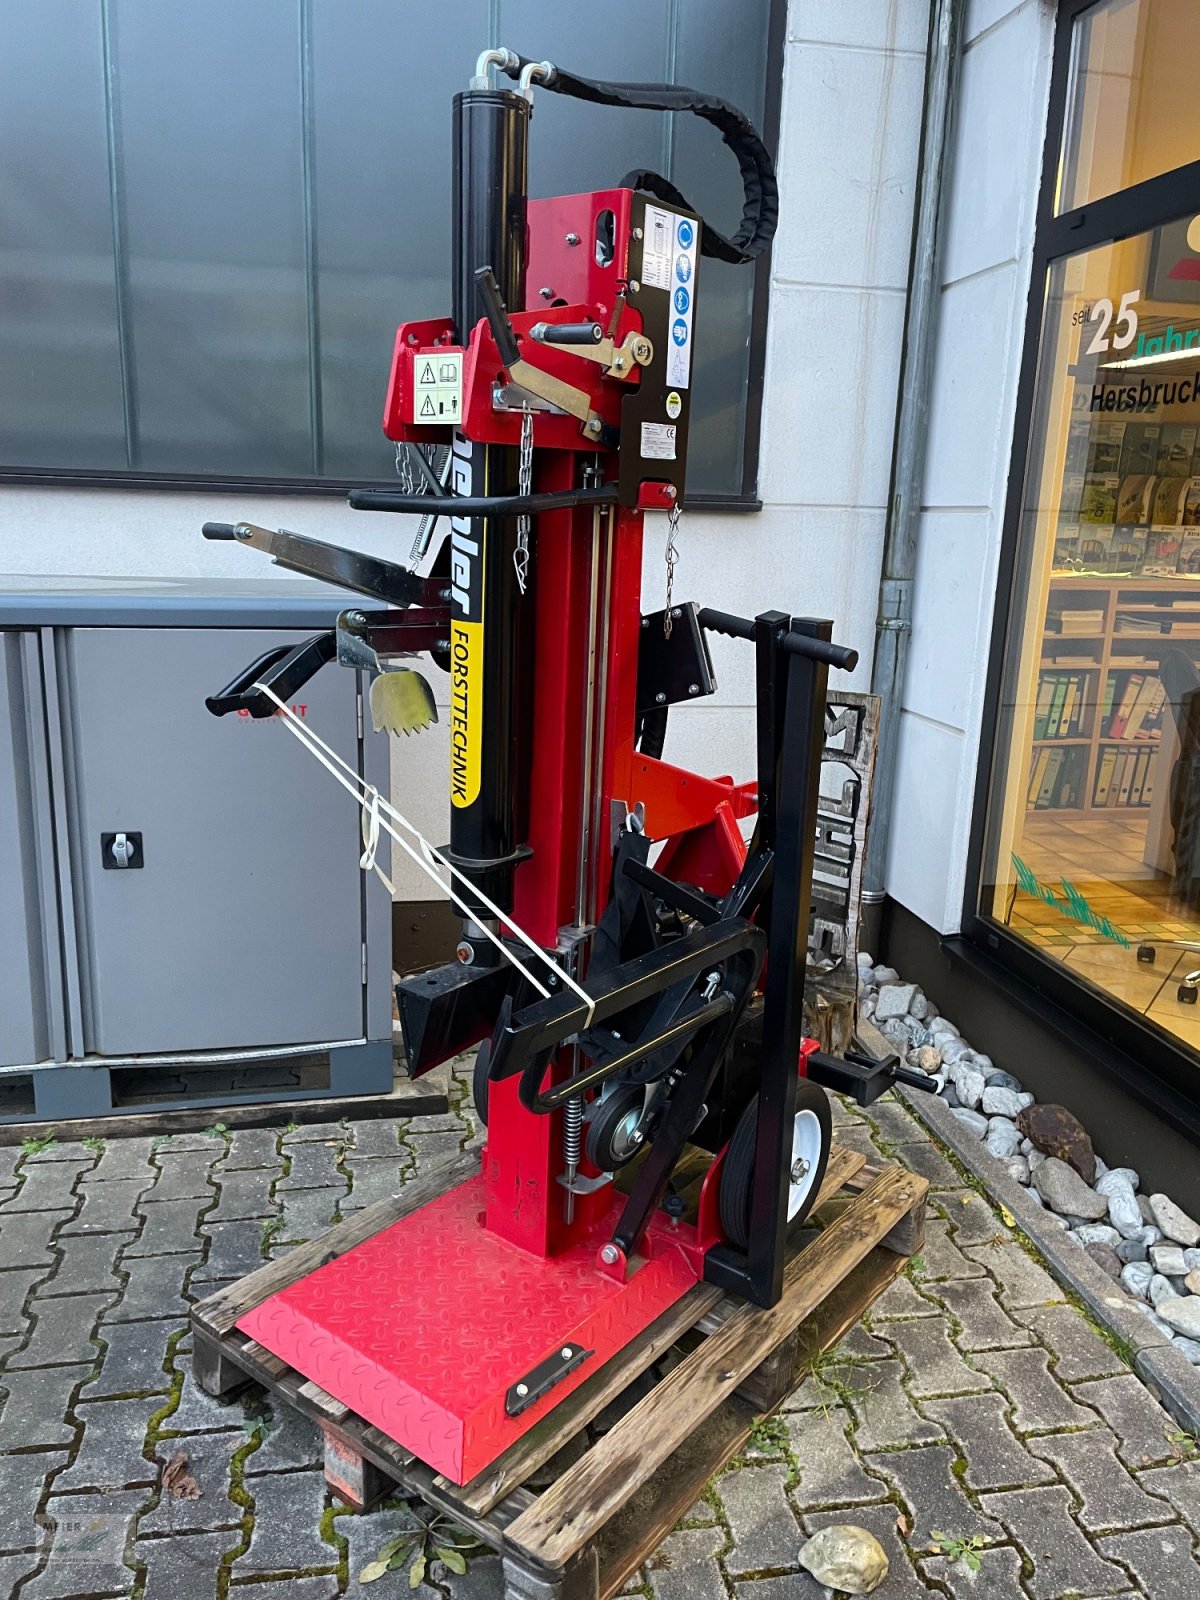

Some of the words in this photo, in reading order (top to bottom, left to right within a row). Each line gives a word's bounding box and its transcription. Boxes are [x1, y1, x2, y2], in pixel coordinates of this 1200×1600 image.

[1072, 305, 1090, 326] seit
[1085, 289, 1140, 355] 25
[1131, 325, 1200, 360] Jahr
[236, 705, 307, 717] GIT
[452, 629, 469, 801] FORSTTECHNIK
